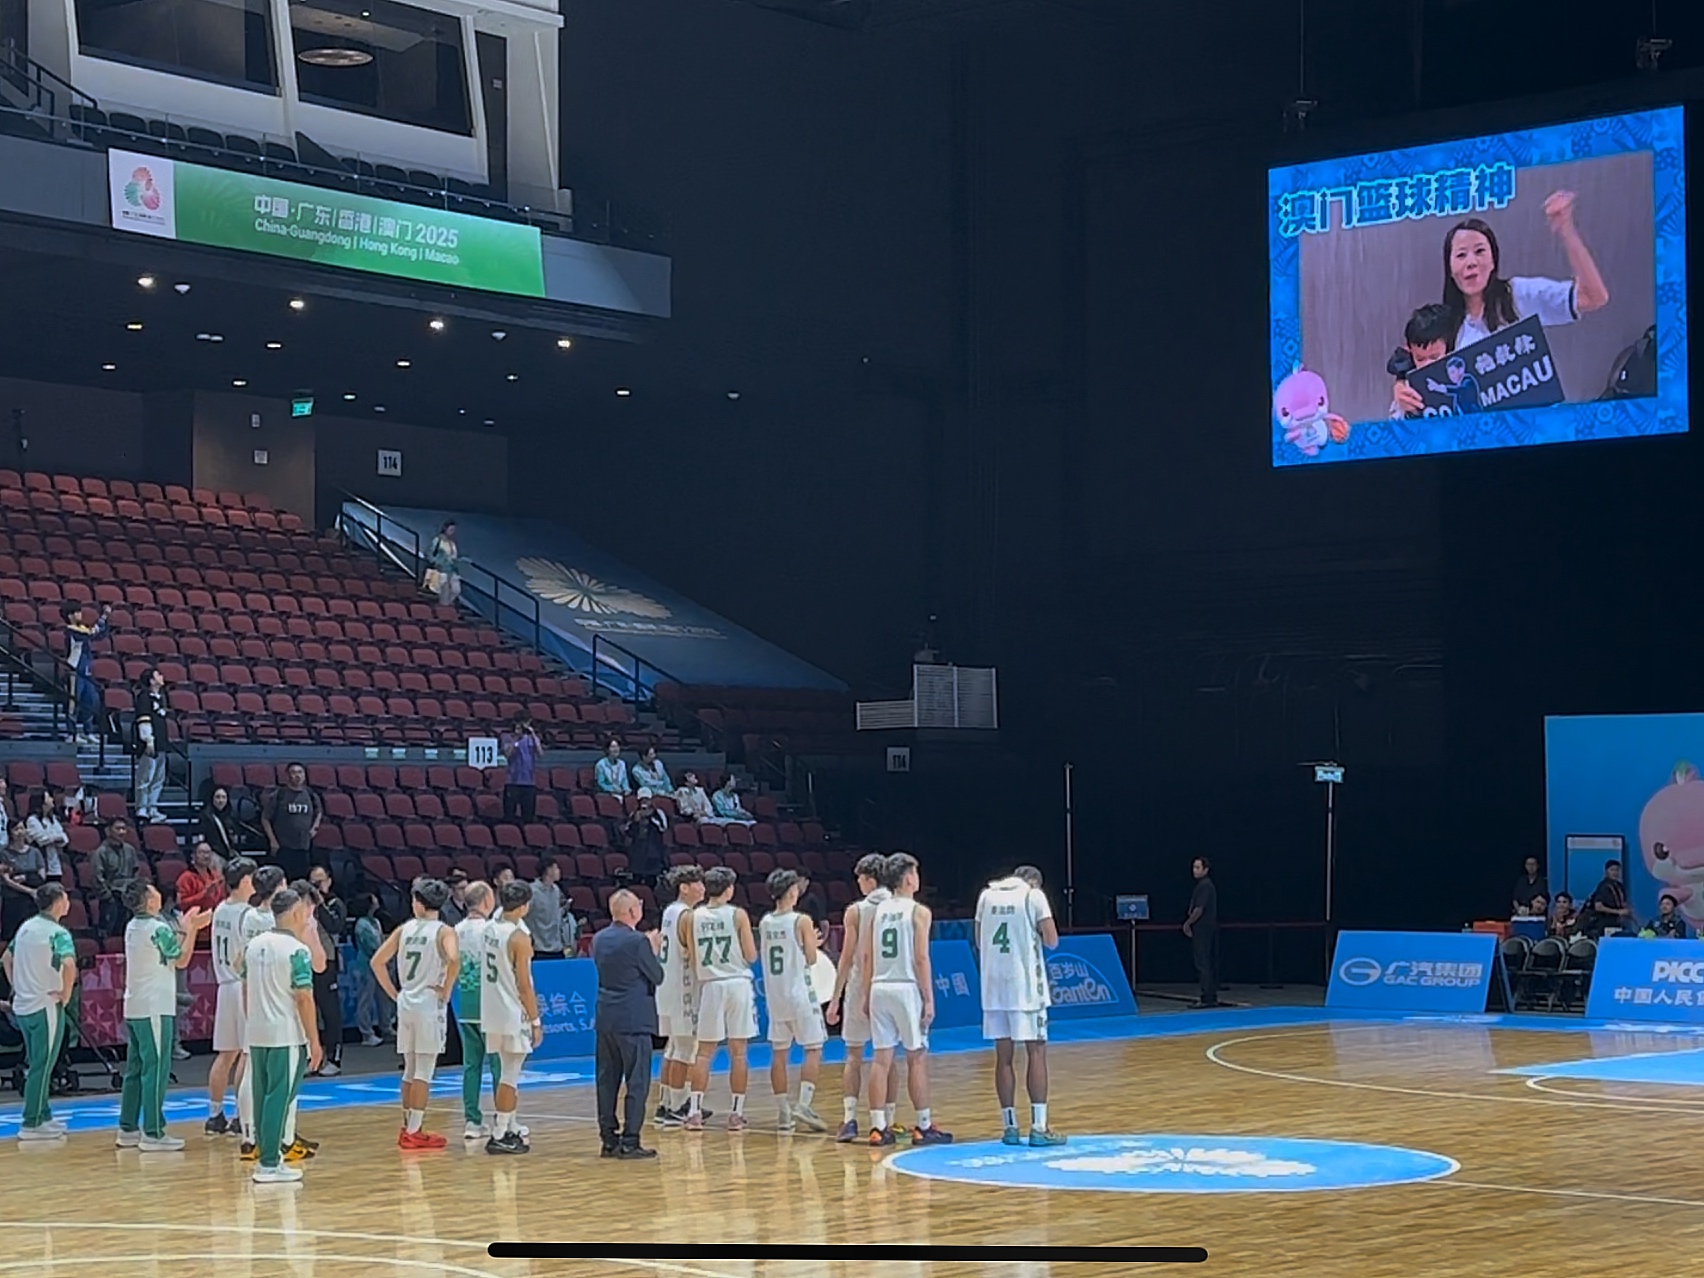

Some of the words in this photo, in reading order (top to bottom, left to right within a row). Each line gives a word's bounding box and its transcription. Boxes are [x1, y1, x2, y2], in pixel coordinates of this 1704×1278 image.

[1278, 163, 1515, 237] 澳门篮球精神
[359, 235, 388, 256] Hong
[390, 242, 418, 261] Kong
[424, 247, 460, 266] Macao
[415, 224, 459, 248] 2025
[1480, 355, 1554, 407] MACAU
[382, 456, 398, 471] 114
[474, 745, 494, 764] 113
[216, 935, 231, 966] 11
[698, 935, 732, 966] 77
[881, 927, 898, 958] 9
[993, 922, 1010, 953] 4
[405, 951, 422, 981] 7
[486, 952, 498, 983] 5
[769, 945, 784, 976] 6
[1384, 961, 1483, 978] 广汽集团
[1652, 960, 1704, 983] PICC
[1383, 975, 1416, 986] GAC
[1419, 976, 1481, 987] GROUP
